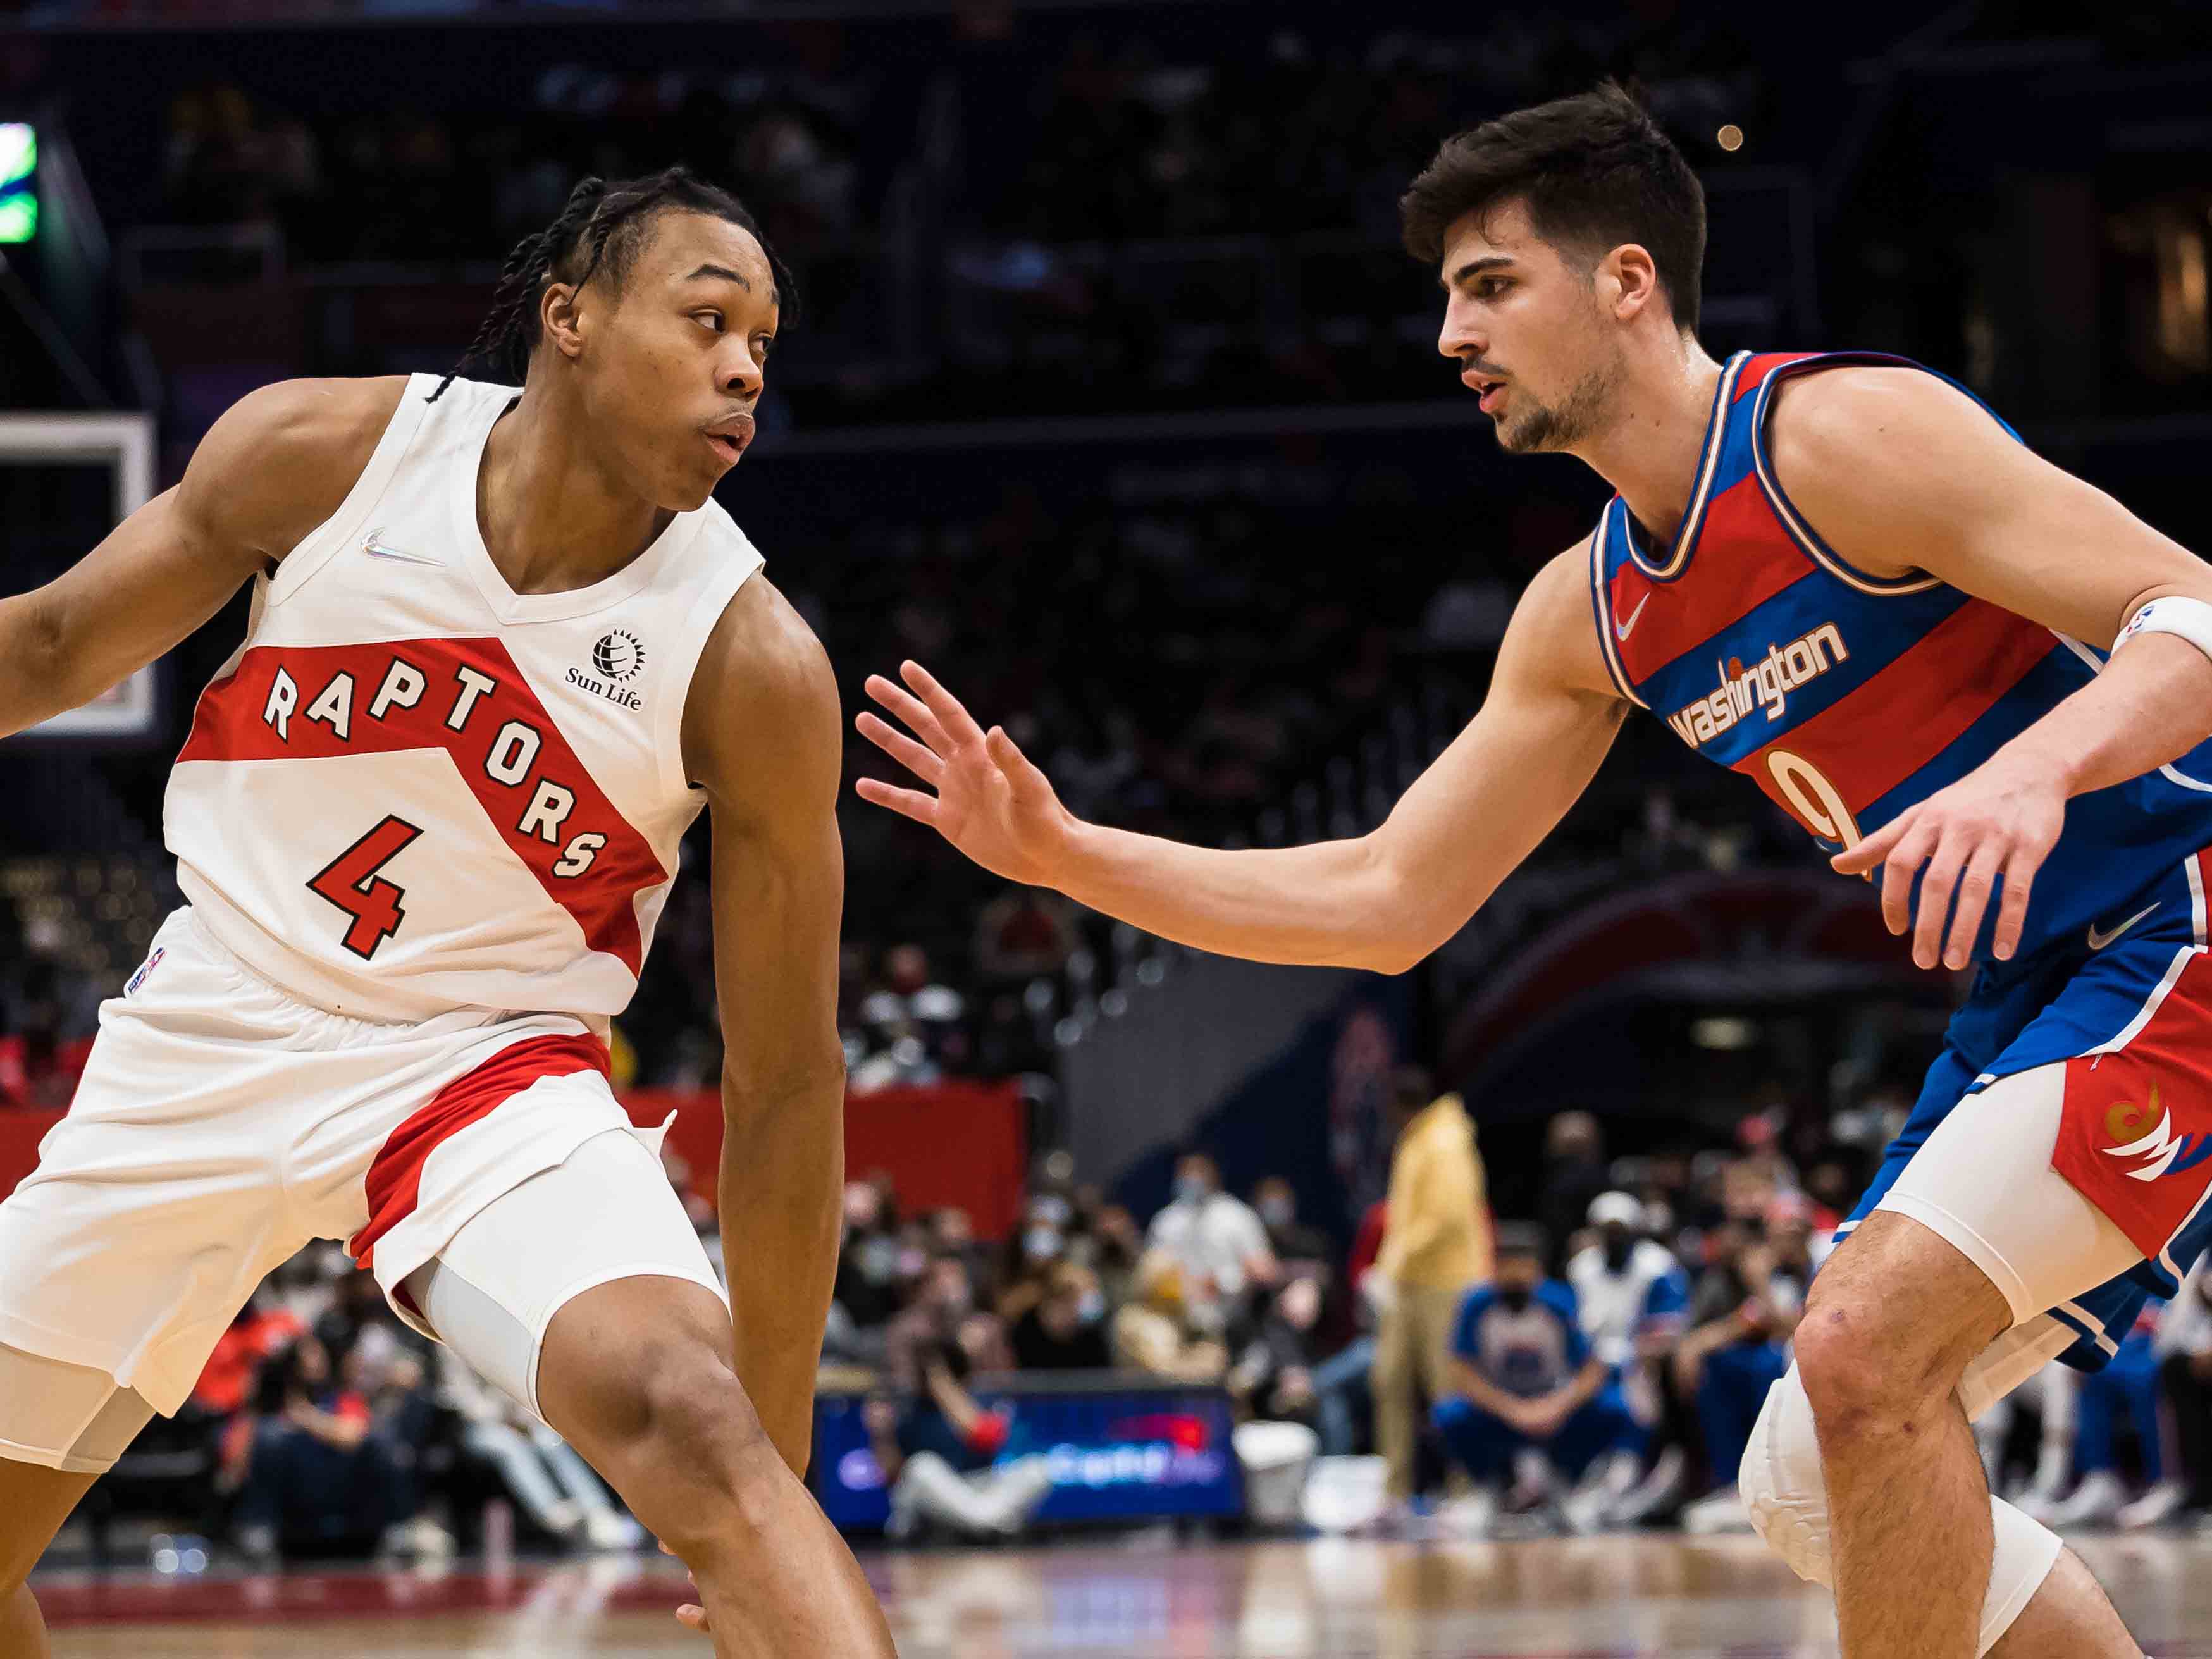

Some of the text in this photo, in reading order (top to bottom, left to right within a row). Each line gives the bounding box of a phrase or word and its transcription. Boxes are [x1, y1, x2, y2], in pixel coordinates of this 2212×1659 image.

[565, 667, 641, 710] Sun Life
[261, 657, 609, 880] RAPTORS
[1767, 749, 1871, 882] 9
[305, 814, 424, 962] 4
